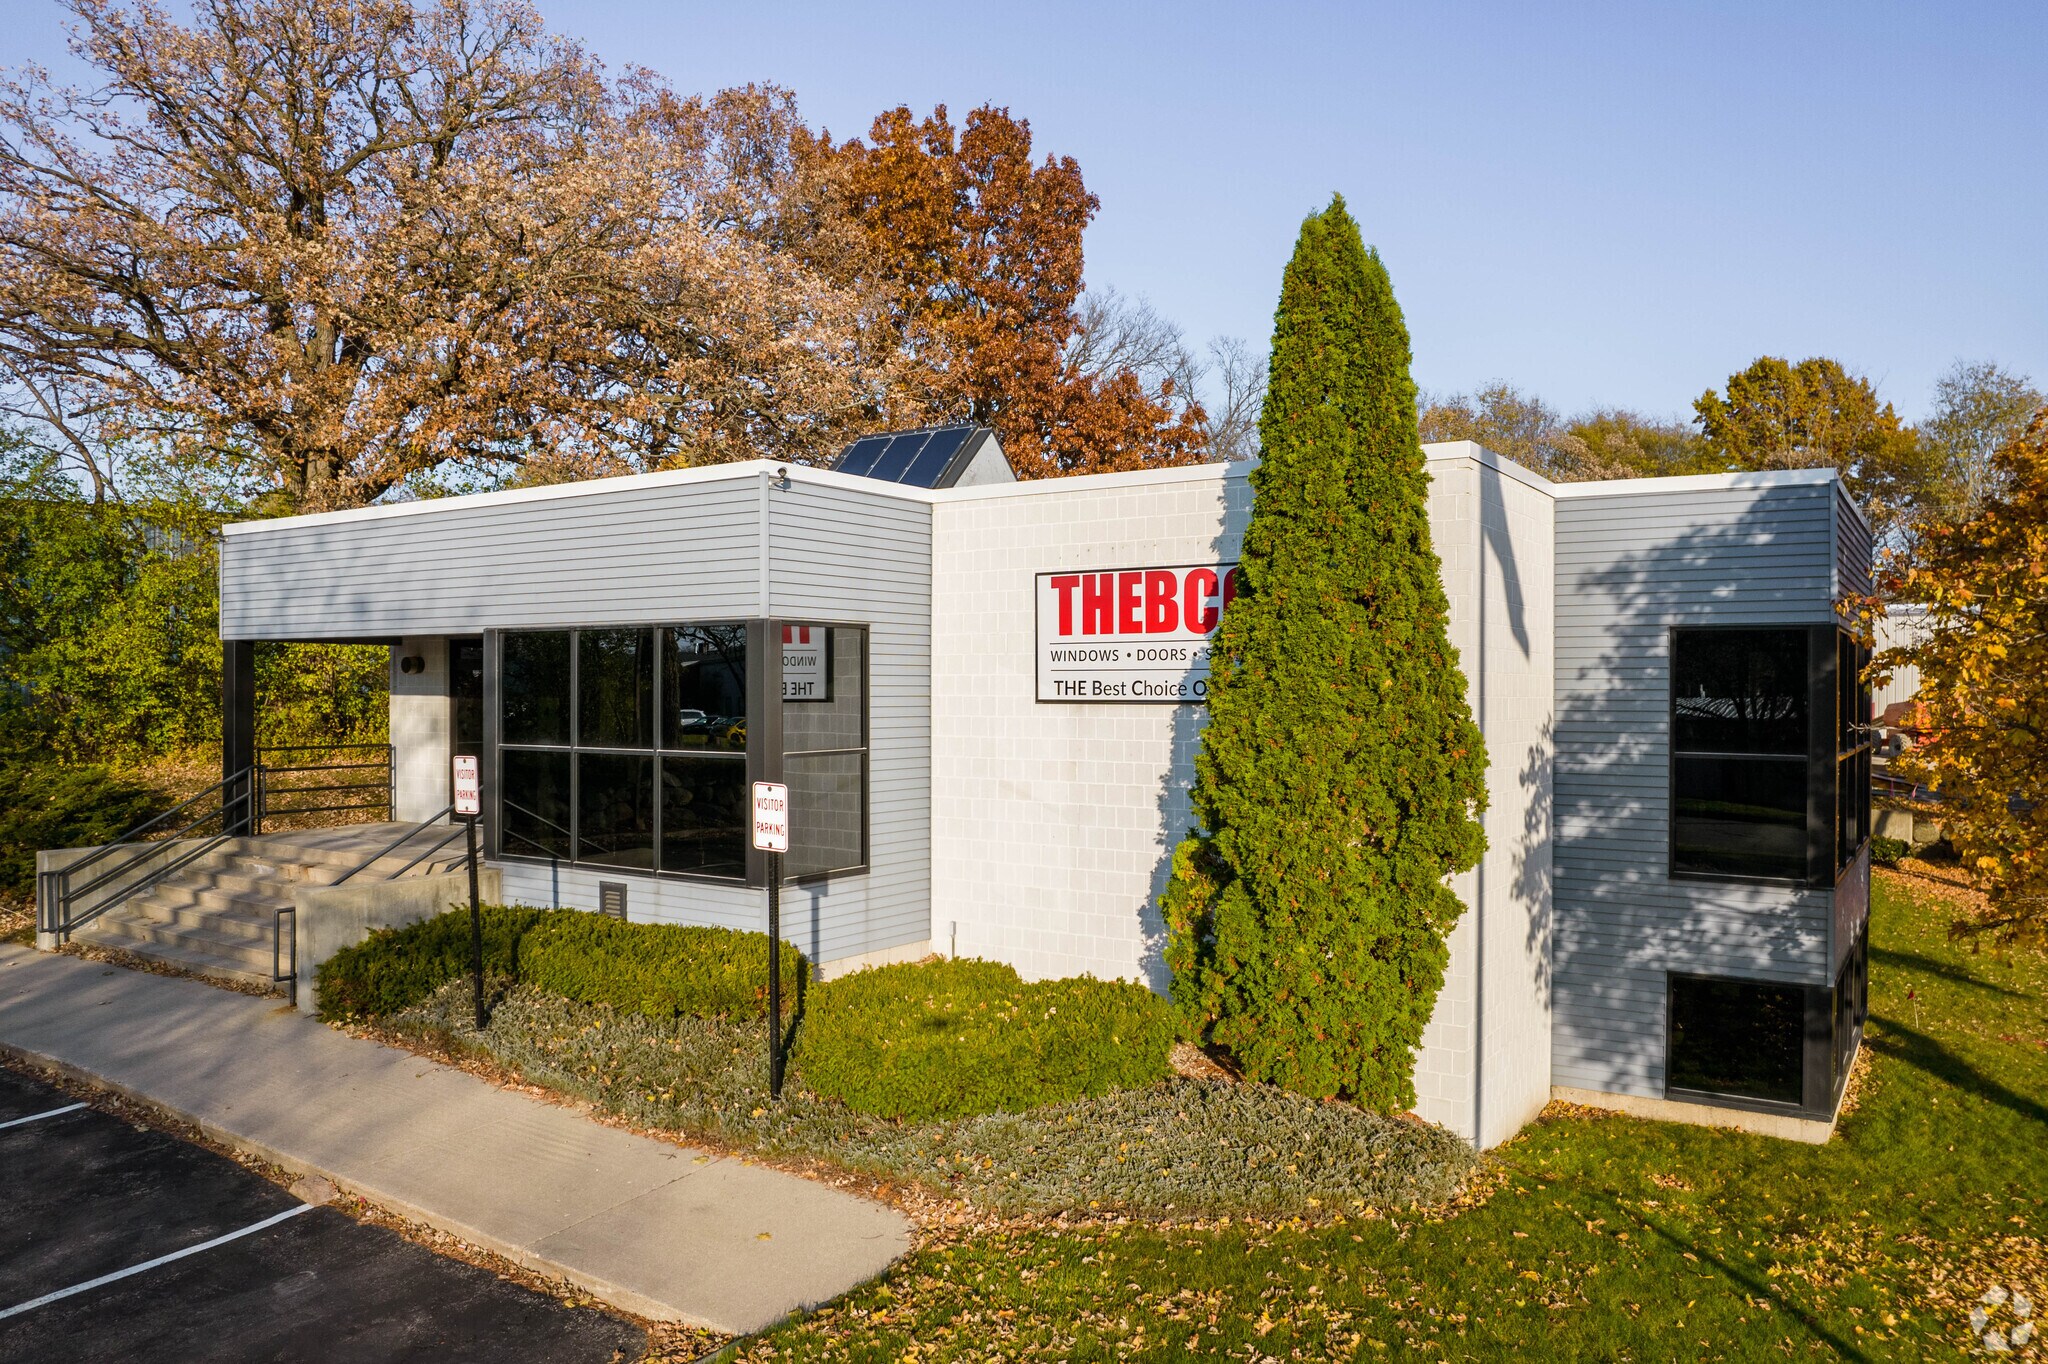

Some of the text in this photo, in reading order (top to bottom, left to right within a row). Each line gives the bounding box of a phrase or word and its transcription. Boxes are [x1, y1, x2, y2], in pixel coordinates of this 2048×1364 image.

[1050, 649, 1119, 662] WINDOWS
[1136, 648, 1187, 661] DOORS
[1054, 680, 1087, 696] THE
[1092, 680, 1127, 696] Best
[1131, 680, 1187, 696] Choice
[756, 797, 784, 812] VISITOR
[756, 821, 785, 837] PARKING
